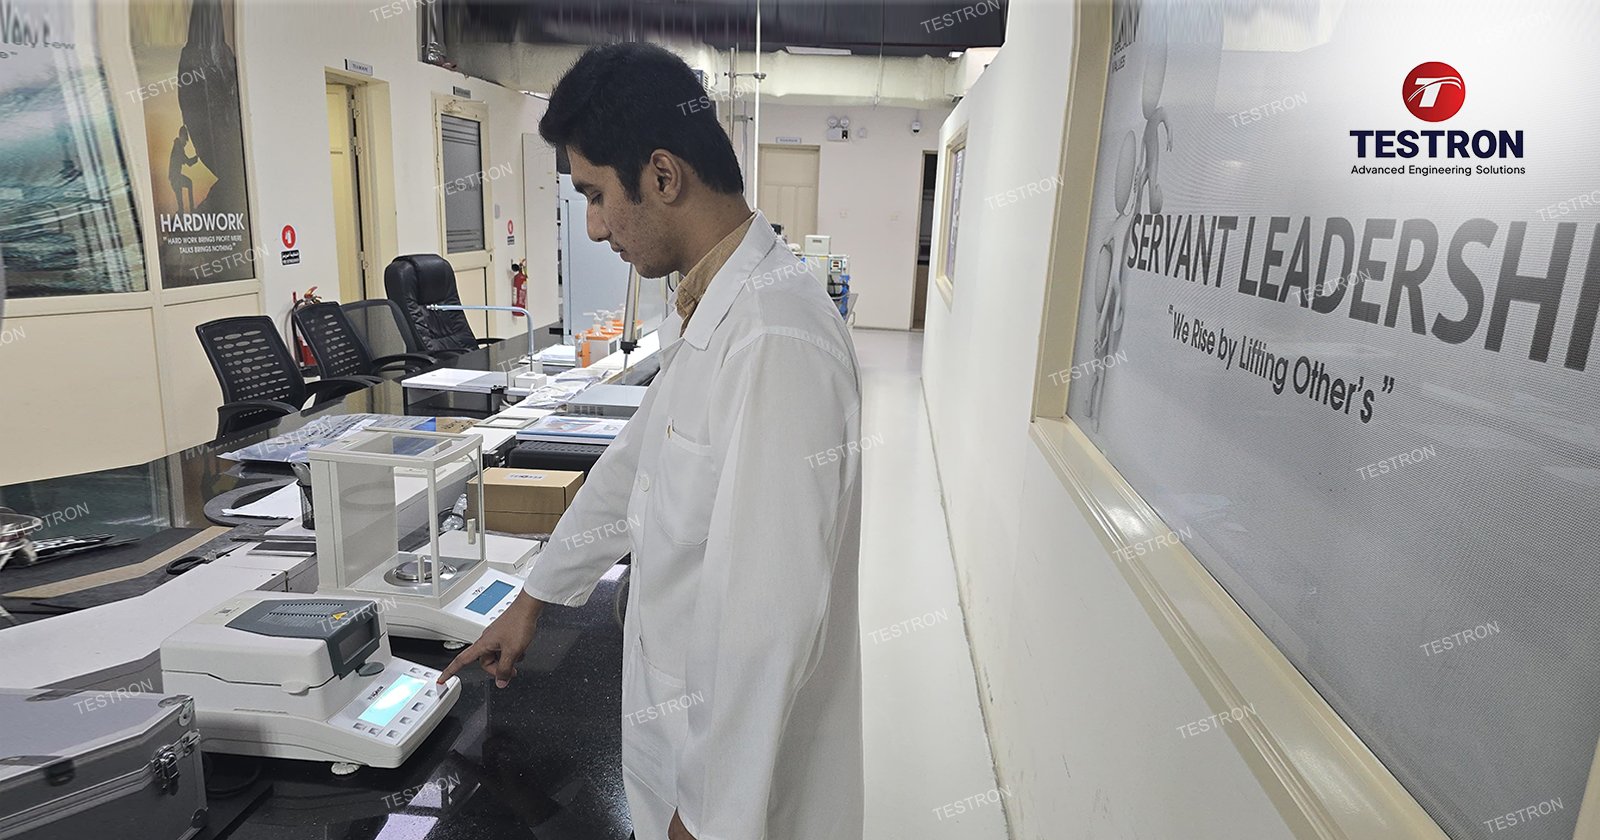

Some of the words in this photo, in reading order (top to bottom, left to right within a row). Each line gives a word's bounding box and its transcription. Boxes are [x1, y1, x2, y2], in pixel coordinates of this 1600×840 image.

[160, 213, 245, 232] HARDWORK
[1127, 213, 1239, 288] SERVANT
[1190, 318, 1215, 355] Rise
[1217, 328, 1238, 370] by
[1239, 335, 1289, 395] Lifting
